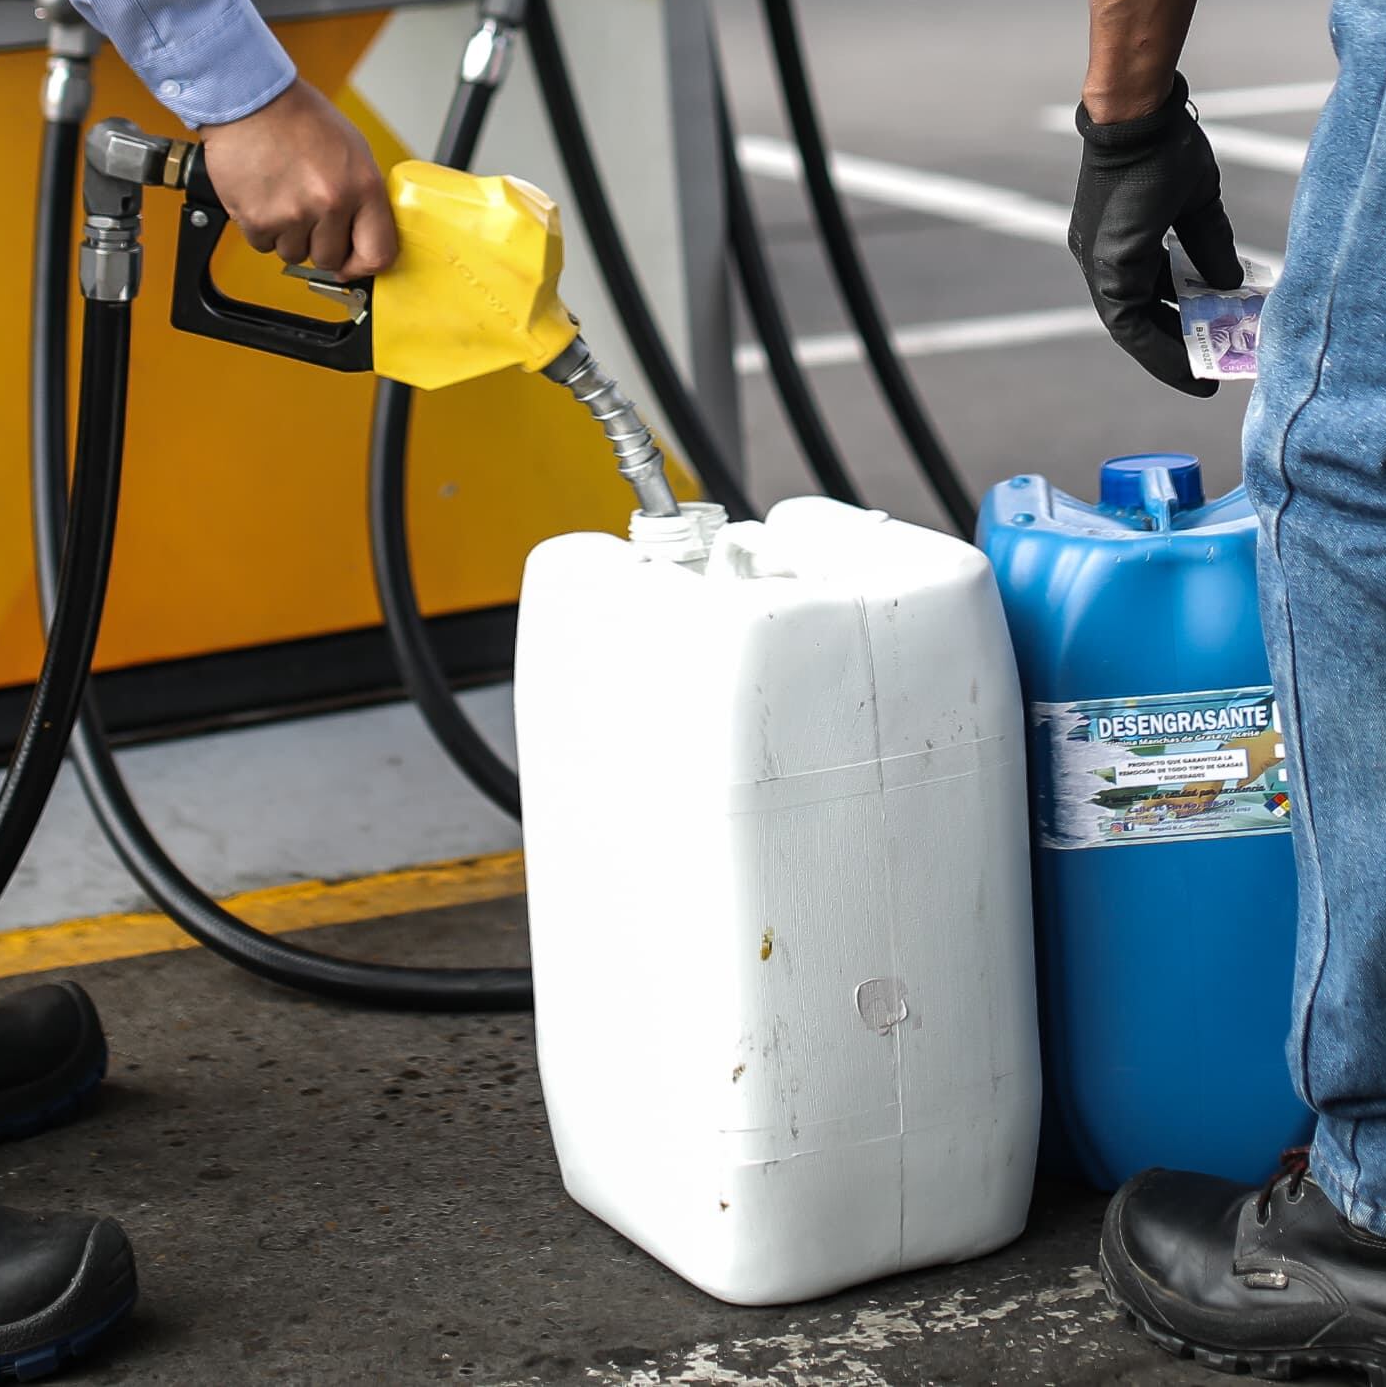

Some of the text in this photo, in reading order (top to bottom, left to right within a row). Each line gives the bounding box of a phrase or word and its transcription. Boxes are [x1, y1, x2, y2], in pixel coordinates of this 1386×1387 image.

[1098, 705, 1269, 739] DESENGRASANTE
[1127, 759, 1165, 768] PRODUCTO
[1182, 755, 1222, 764] GARANTIZA
[1167, 765, 1188, 773] TODO
[1216, 761, 1244, 769] GRASAS
